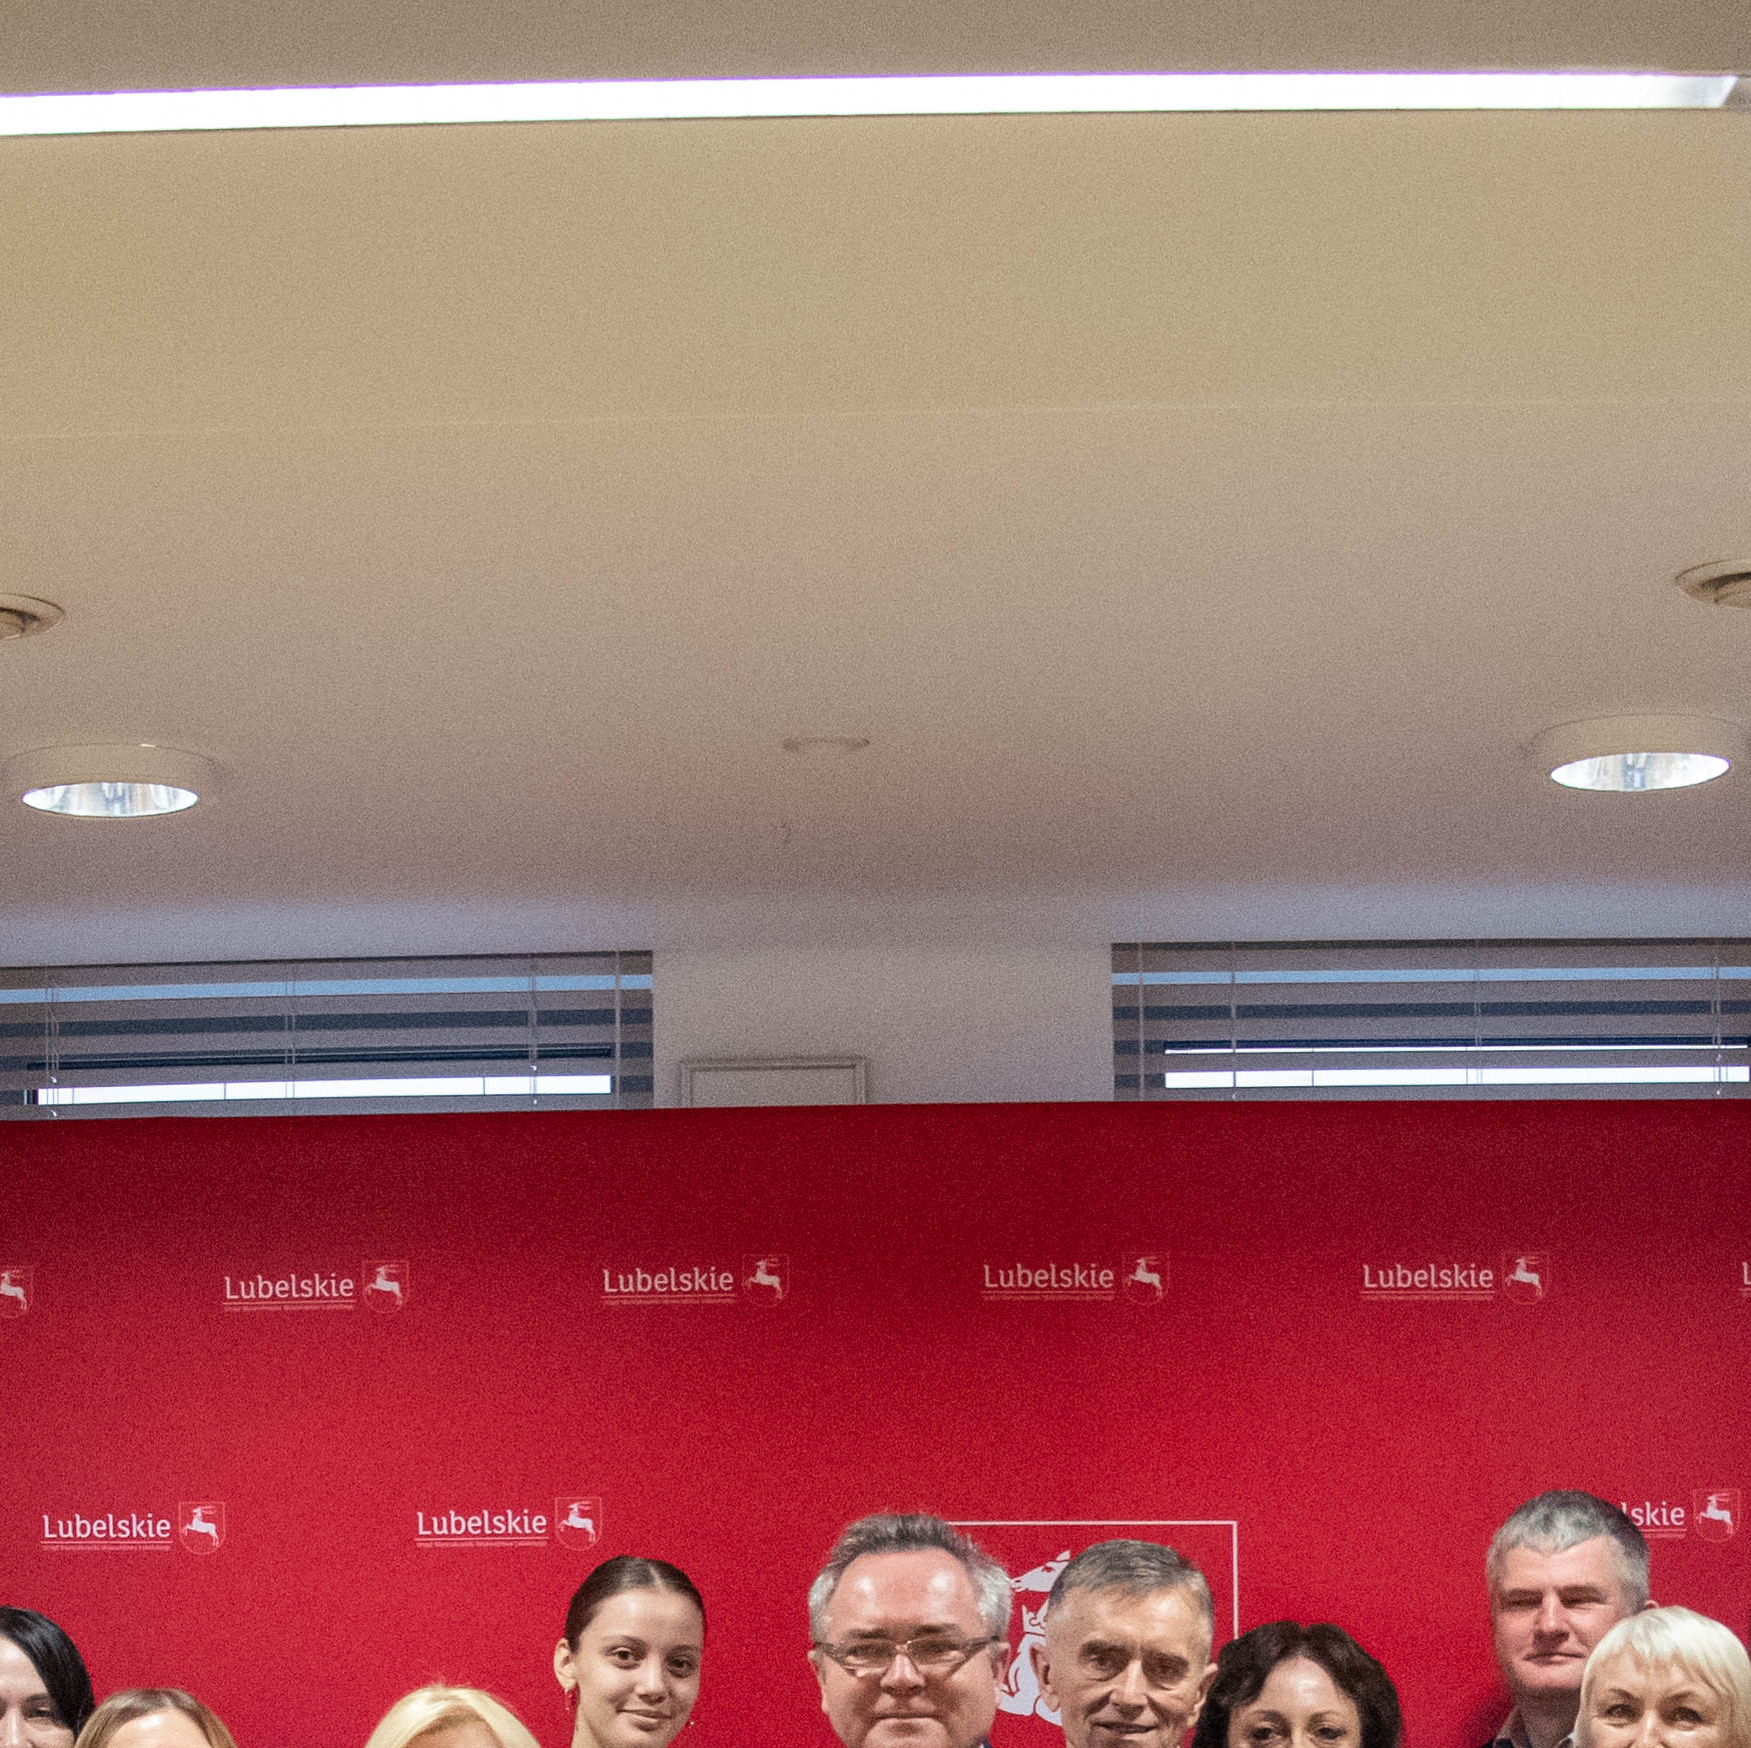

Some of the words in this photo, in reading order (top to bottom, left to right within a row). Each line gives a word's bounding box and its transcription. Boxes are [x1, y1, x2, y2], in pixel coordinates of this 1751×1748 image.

[224, 1272, 354, 1300] Lubelskie
[603, 1266, 734, 1293] Lubelskie
[983, 1263, 1115, 1290] Lubelskie
[1362, 1263, 1495, 1290] Lubelskie
[41, 1513, 171, 1539] Lubelskie
[416, 1509, 547, 1536] Lubelskie
